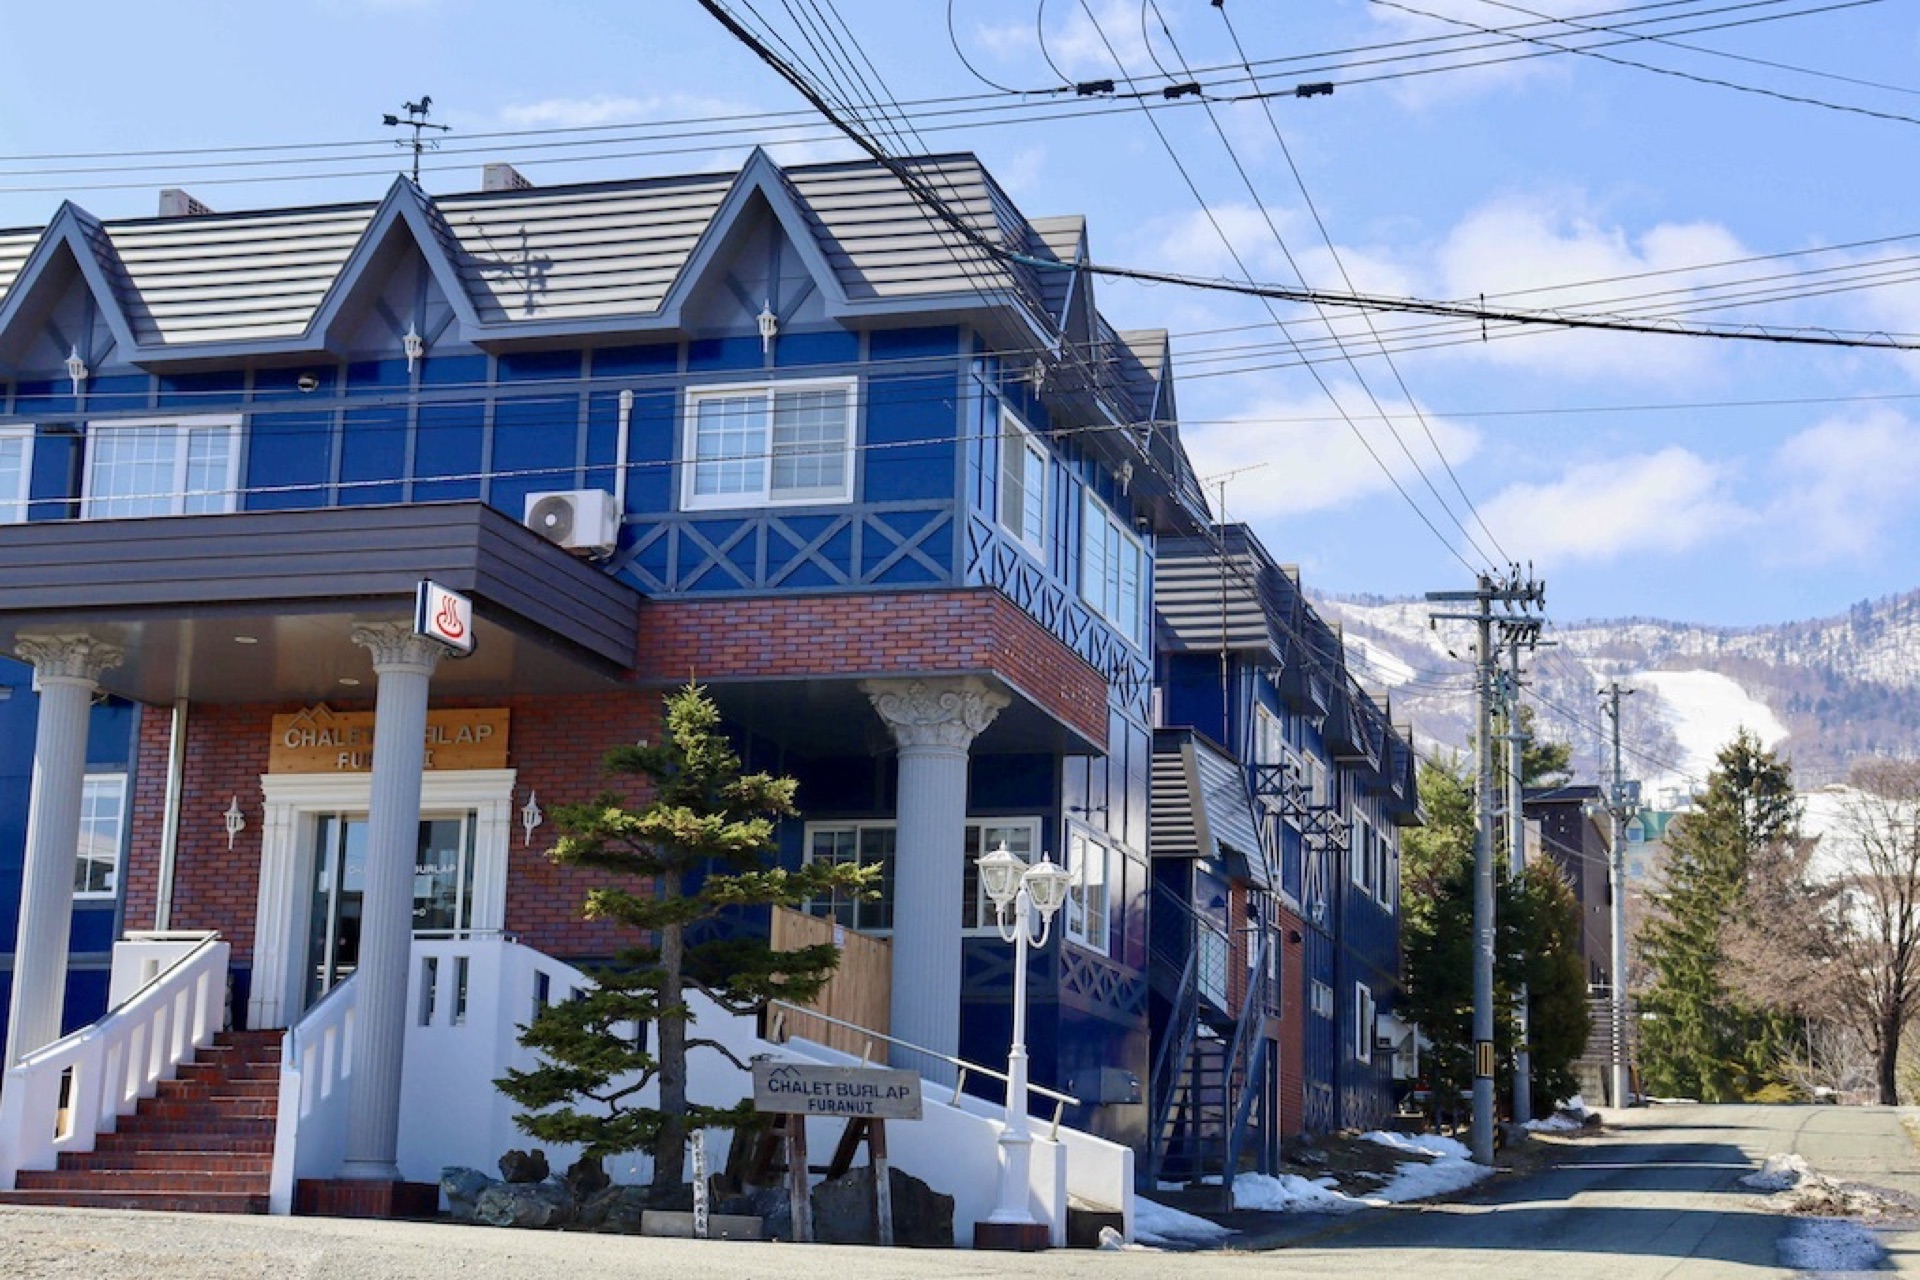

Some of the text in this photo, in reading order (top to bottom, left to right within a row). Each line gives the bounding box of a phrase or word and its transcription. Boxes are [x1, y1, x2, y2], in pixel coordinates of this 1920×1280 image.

[424, 724, 493, 745] RLAP
[768, 1078, 910, 1100] CHALET BURLAP
[808, 1098, 874, 1114] FURANUI
